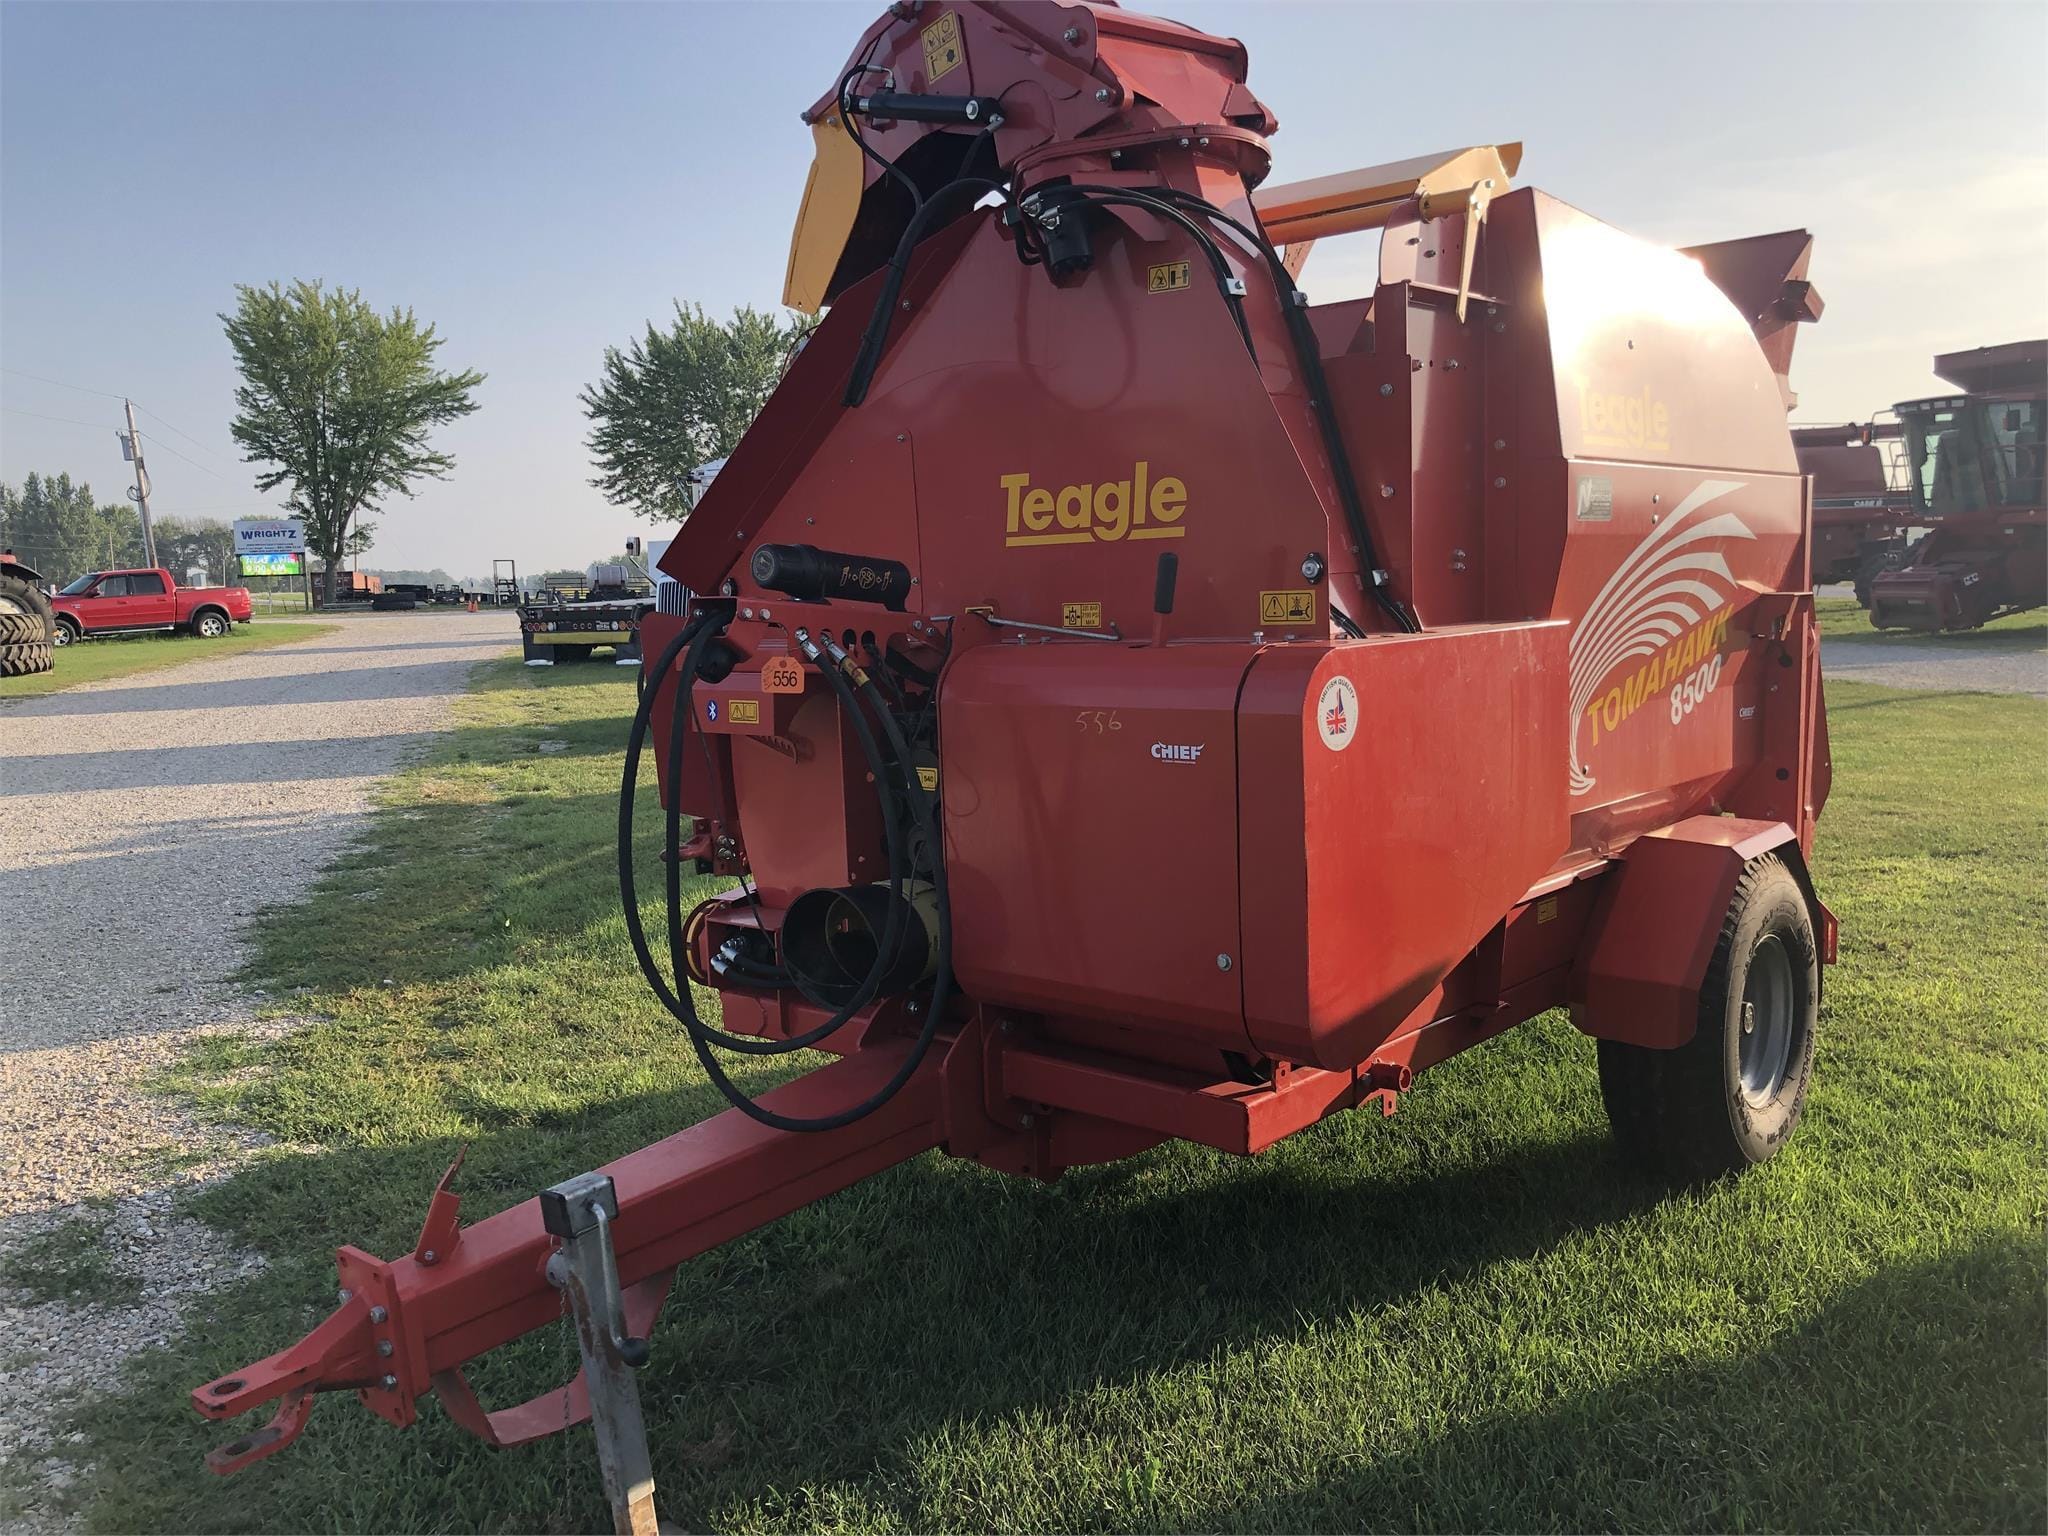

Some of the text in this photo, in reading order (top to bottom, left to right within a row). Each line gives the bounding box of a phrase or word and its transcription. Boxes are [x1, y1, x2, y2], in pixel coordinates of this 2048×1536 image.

[1000, 461, 1187, 541] Teagle
[241, 529, 297, 540] WRIGHTZ
[773, 670, 798, 687] 556
[1587, 602, 1735, 747] TOMAHAWK
[1670, 653, 1722, 726] 8500
[1075, 710, 1122, 735] 556
[1151, 741, 1205, 760] CHIEF
